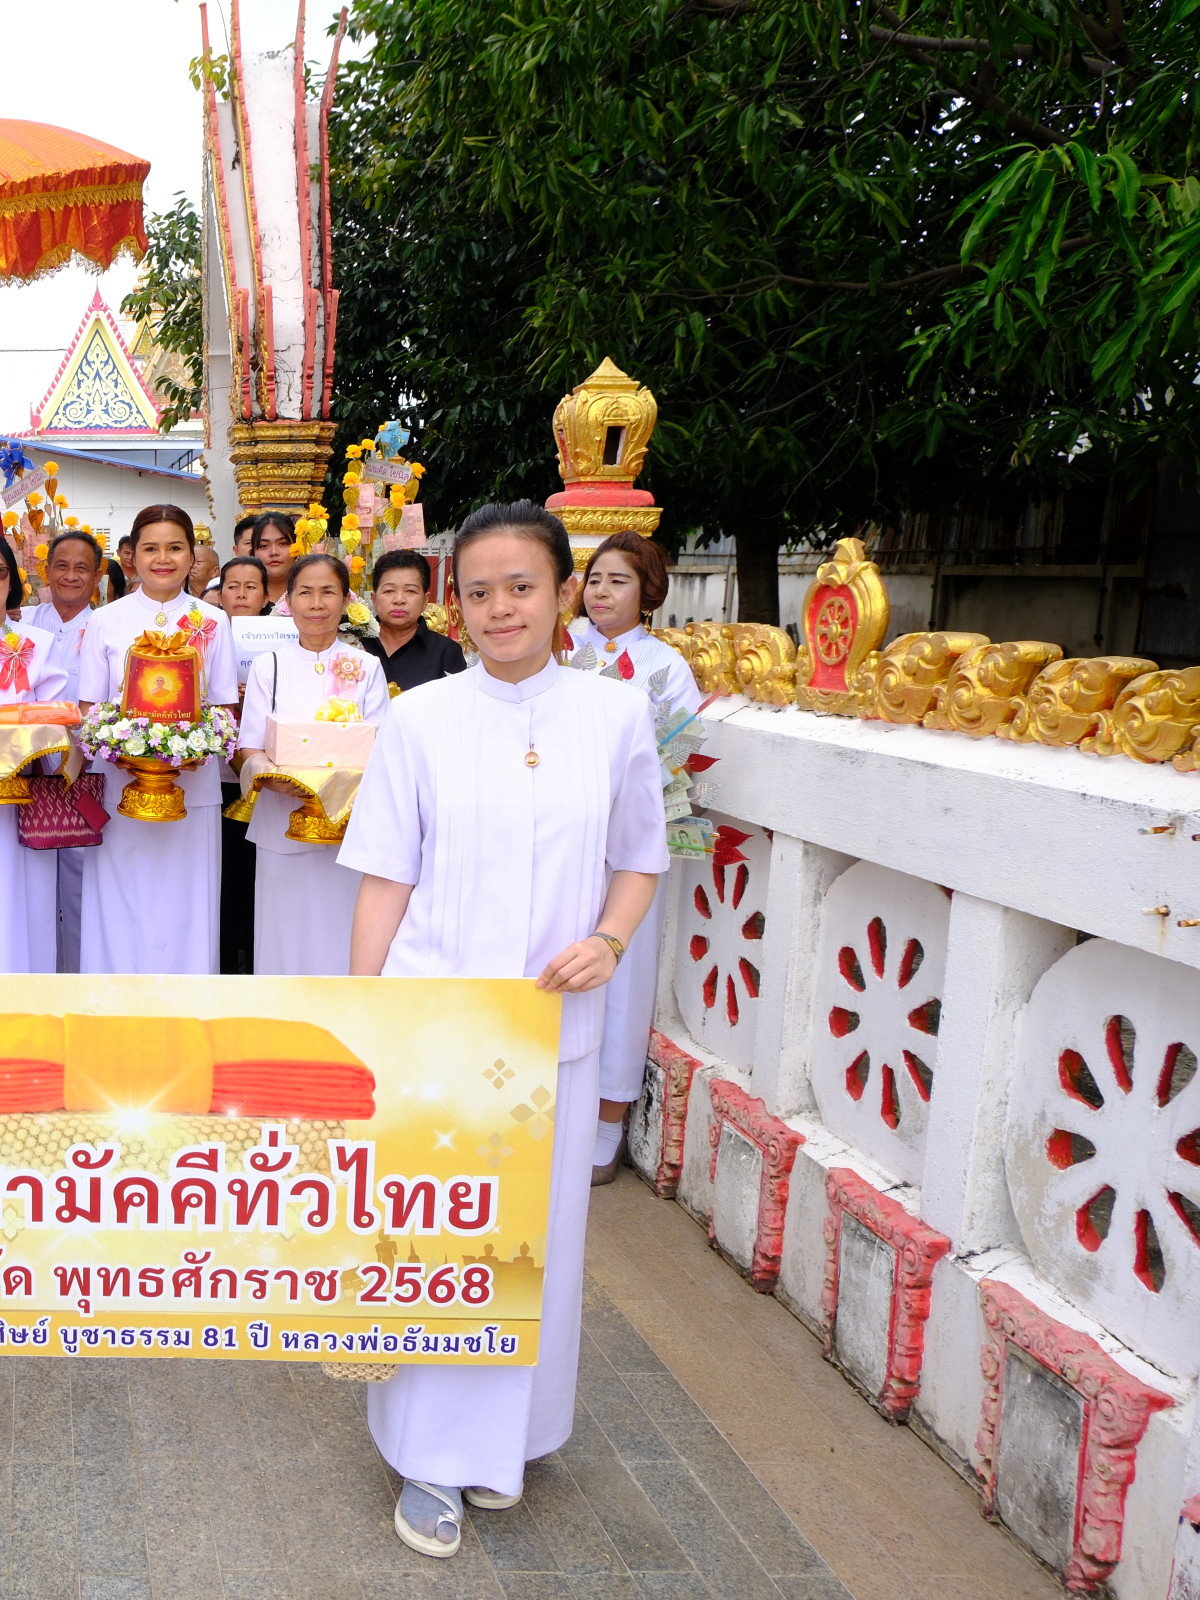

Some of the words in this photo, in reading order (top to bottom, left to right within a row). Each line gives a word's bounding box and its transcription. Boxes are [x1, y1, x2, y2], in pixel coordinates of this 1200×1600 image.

[53, 1251, 342, 1313] พุทธศักราช
[359, 1264, 491, 1305] 2568
[60, 1325, 191, 1355] บูชาธรรม
[203, 1327, 237, 1348] 81
[250, 1321, 271, 1349] ปี
[281, 1325, 517, 1355] หลวงพ่อธัมมชโย
